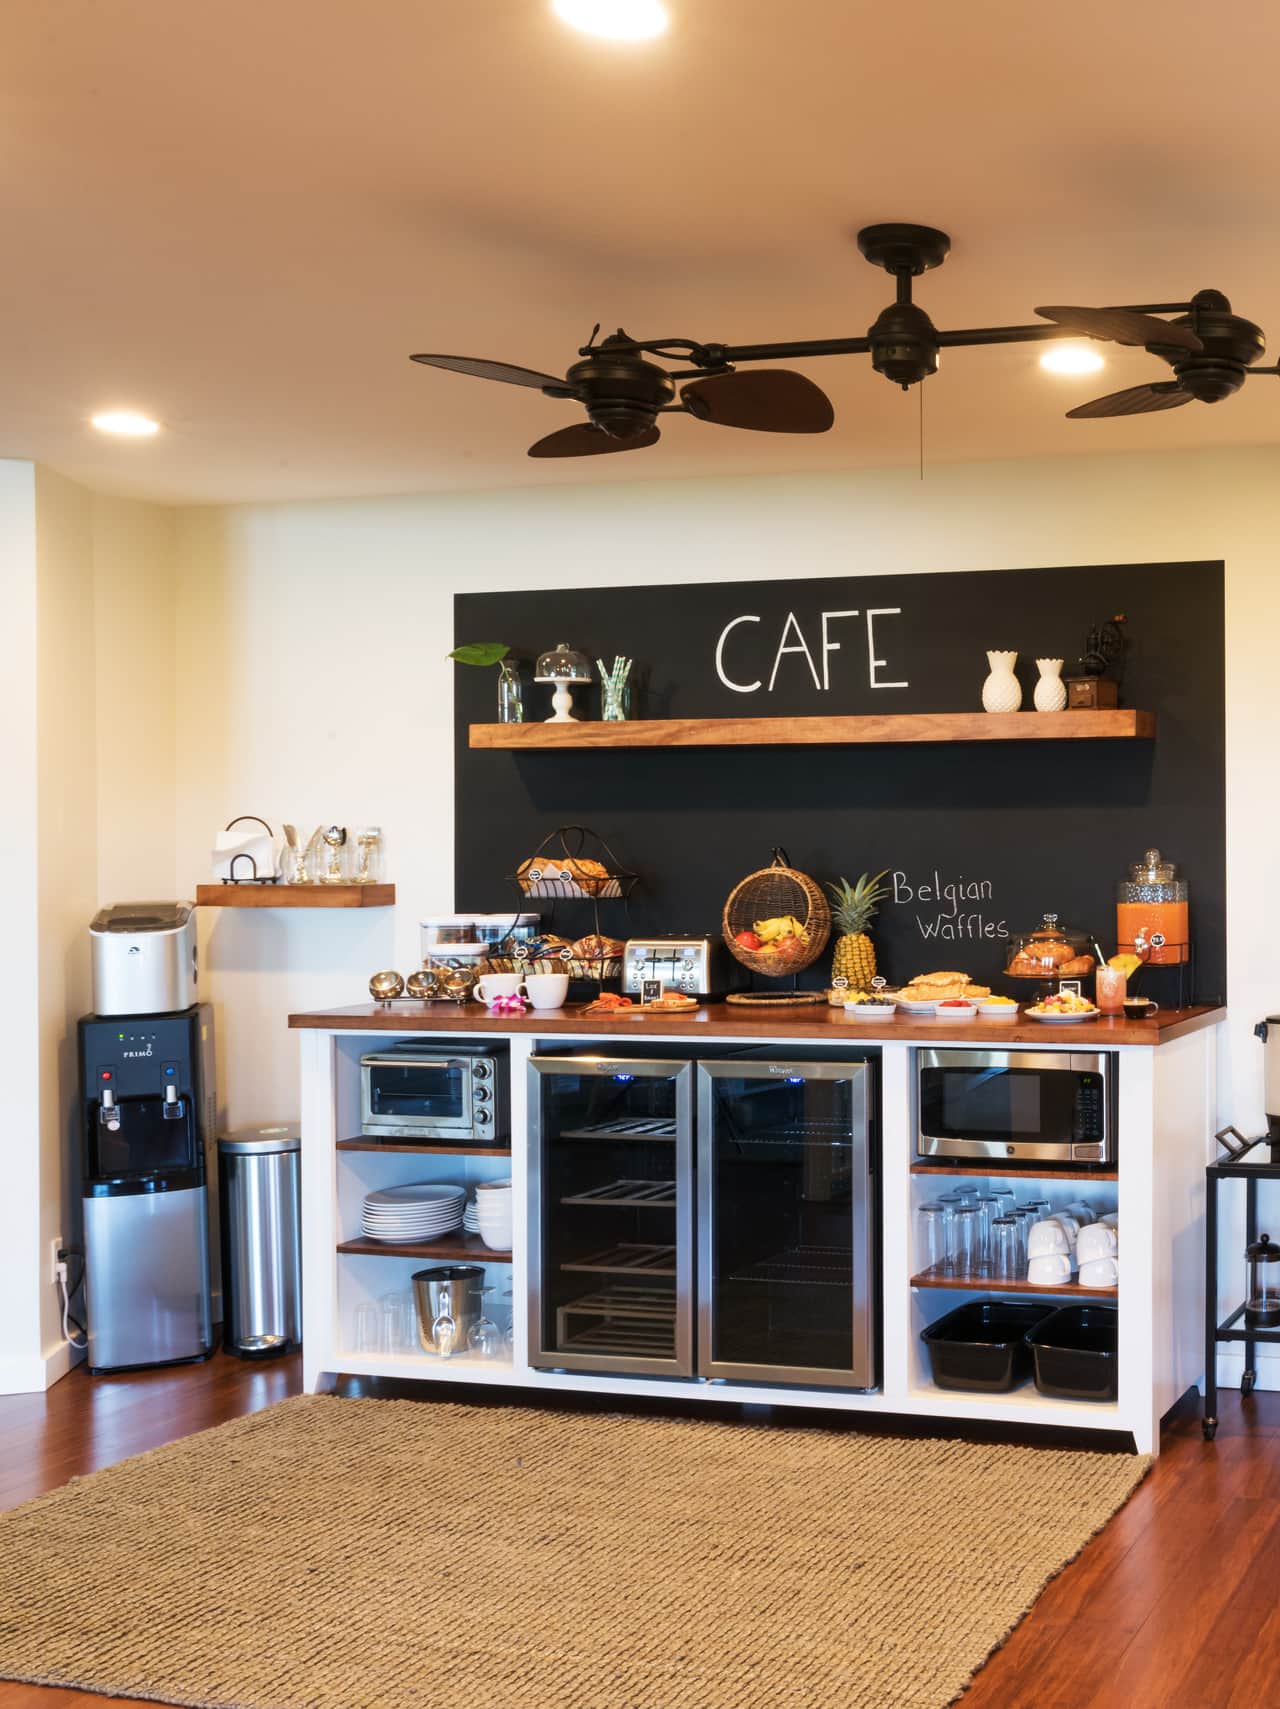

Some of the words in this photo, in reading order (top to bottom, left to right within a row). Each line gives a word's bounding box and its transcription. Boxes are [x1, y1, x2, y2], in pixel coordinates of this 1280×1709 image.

[716, 607, 909, 693] CAFE
[893, 870, 992, 918] Belgian
[916, 913, 1009, 940] Waffles
[123, 1047, 153, 1058] PRIMO
